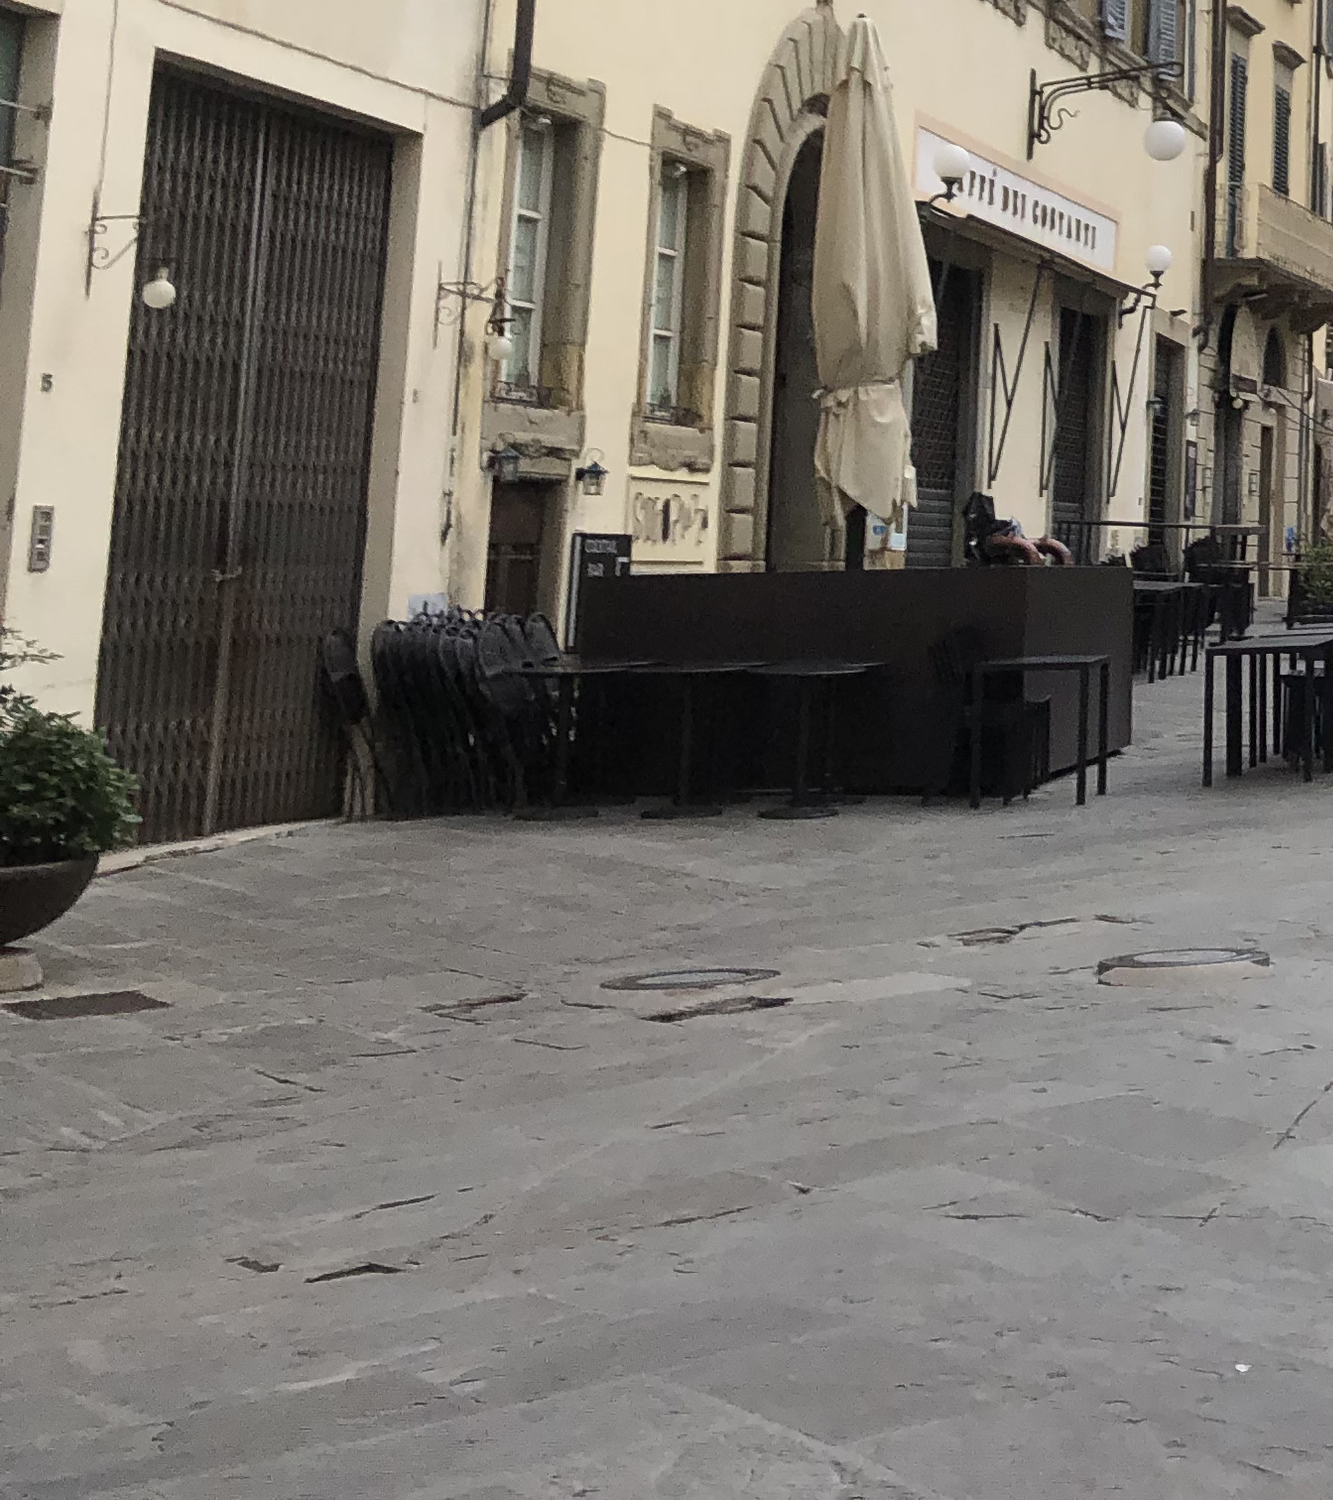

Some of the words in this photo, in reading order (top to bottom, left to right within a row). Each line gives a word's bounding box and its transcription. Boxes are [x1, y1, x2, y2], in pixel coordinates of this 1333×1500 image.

[1001, 185, 1027, 220] DEI
[1032, 199, 1097, 251] COSTANTI
[41, 372, 53, 392] 5
